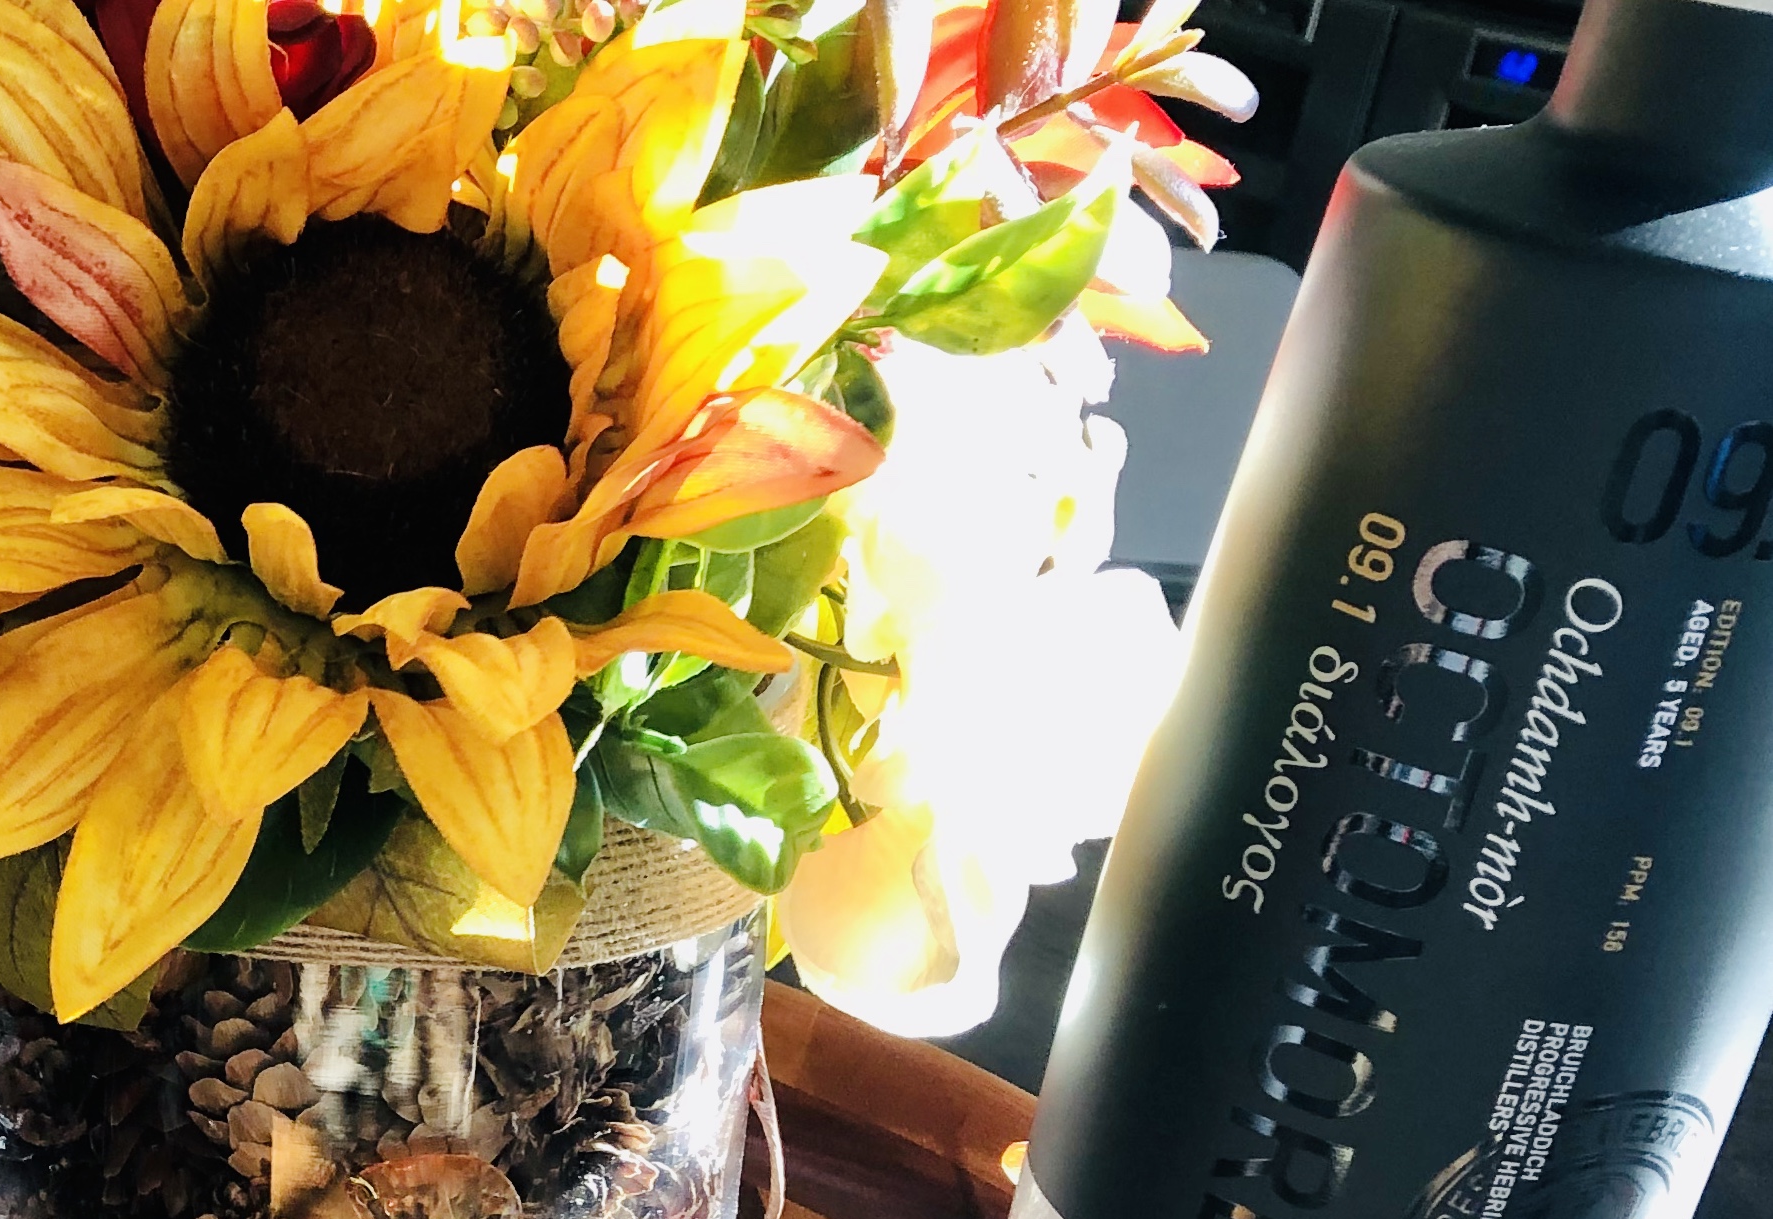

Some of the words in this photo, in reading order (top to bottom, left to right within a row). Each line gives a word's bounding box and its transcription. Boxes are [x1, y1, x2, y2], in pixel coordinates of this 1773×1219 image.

[1331, 512, 1406, 624] 09.1
[1637, 697, 1683, 770] YEARS
[1504, 1021, 1571, 1157] PROGRESSIVE
[1520, 1023, 1595, 1182] BRUICHLADDICH
